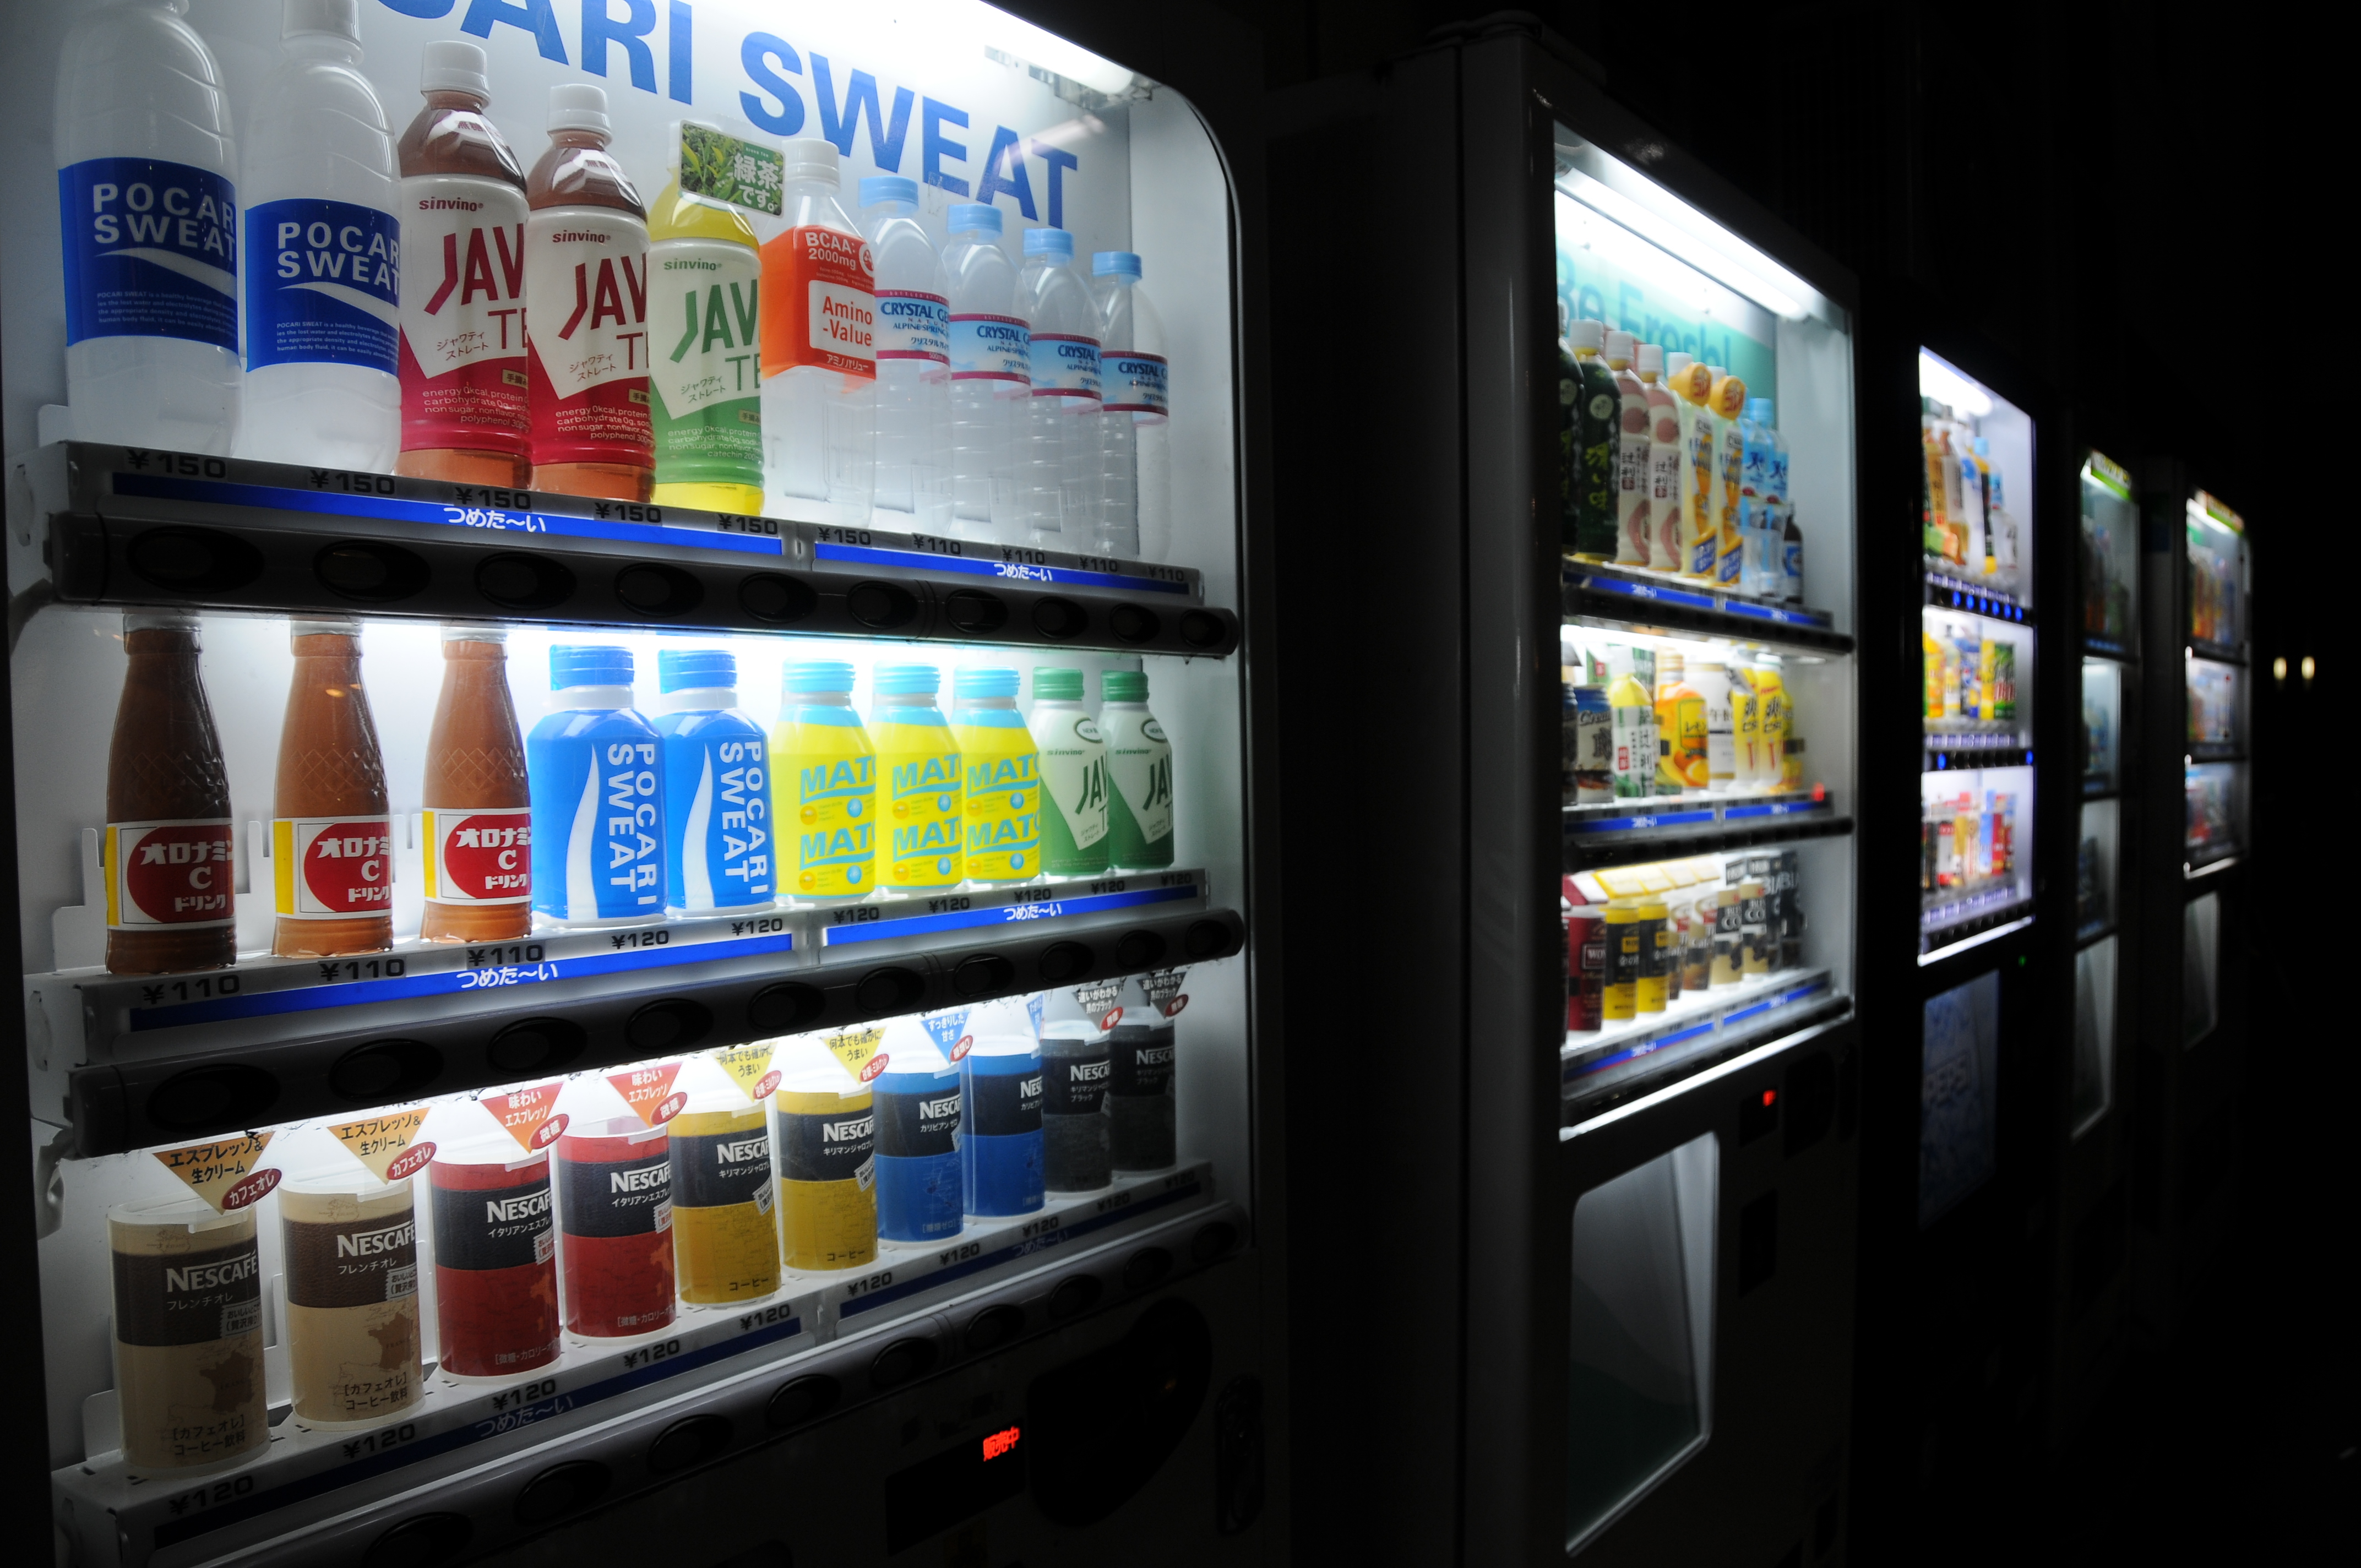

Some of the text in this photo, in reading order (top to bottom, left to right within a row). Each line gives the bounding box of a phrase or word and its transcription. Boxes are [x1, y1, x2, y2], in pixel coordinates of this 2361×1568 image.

[379, 0, 1078, 230] ARI SWEAT
[733, 152, 780, 192] 緑茶
[739, 184, 776, 212] です。
[94, 214, 236, 262] SWEAT
[805, 232, 855, 254] BCAA:
[808, 248, 856, 270] 2000mg
[277, 250, 400, 296] SWEAT
[822, 296, 873, 325] Amino
[880, 302, 934, 319] CRYSTAL
[823, 319, 873, 346] -Value
[893, 323, 921, 331] ALPINE
[976, 325, 1021, 342] CRYSTAL
[437, 331, 485, 351] ジャワティ
[445, 344, 488, 361] ストレート
[1058, 345, 1096, 361] CRYSTAL
[569, 353, 613, 373] ジャワティ
[577, 364, 617, 382] ストレート
[826, 354, 868, 372] アミノバリュー
[1118, 361, 1159, 377] CRYSTAL
[681, 375, 723, 395] ジャワティ
[688, 385, 726, 404] ストレート
[556, 407, 591, 417] energy
[618, 409, 647, 418] protein
[557, 414, 622, 425] carbohydrate
[590, 432, 635, 440] polyphenol
[127, 448, 227, 480] ¥150
[309, 469, 396, 495] ¥150
[455, 486, 532, 511] ¥150
[595, 502, 661, 524] ¥150
[719, 514, 778, 535] ¥150
[818, 526, 872, 546] ¥150
[913, 534, 961, 556] ¥110
[1003, 548, 1046, 564] ¥110
[1079, 556, 1118, 573] ¥110
[1148, 565, 1184, 582] ¥110
[607, 743, 637, 893] SWEAT
[719, 741, 749, 884] SWEAT
[745, 741, 769, 895] POCARI
[635, 743, 658, 906] POCARI
[498, 850, 518, 870] C
[189, 867, 212, 890] C
[361, 860, 380, 882] C
[1161, 873, 1192, 886] ¥120
[485, 874, 527, 890] ドリンク
[1091, 881, 1125, 895] ¥120
[174, 893, 227, 913] ドリンク
[348, 887, 391, 903] ドリンク
[929, 897, 970, 913] ¥120
[1014, 889, 1052, 903] ¥120
[834, 907, 879, 923] ¥120
[732, 918, 783, 936] ¥120
[612, 930, 670, 950] ¥120
[469, 945, 543, 967] ¥110
[320, 959, 406, 983] ¥110
[143, 975, 240, 1005] ¥110
[1078, 986, 1118, 1003] 違いがわかる
[928, 1014, 965, 1032] すっきりした
[942, 1029, 955, 1042] 甘さ
[846, 1049, 868, 1062] うまい
[632, 1069, 662, 1087] 味わい
[738, 1064, 760, 1078] うまい
[509, 1089, 542, 1110] 味わい
[629, 1084, 668, 1103] エスプレッソ
[505, 1105, 547, 1128] エスプレッソ
[660, 1096, 679, 1119] 微糖
[539, 1118, 561, 1144] 微糖
[920, 1121, 949, 1133] カリビアン
[360, 1134, 406, 1156] 生クリーム
[391, 1145, 432, 1178] カフェオレ
[191, 1159, 246, 1185] 生クリーム
[1165, 1172, 1195, 1190] ¥120
[229, 1173, 275, 1207] カフェオレ
[1097, 1193, 1130, 1211] ¥120
[1022, 1217, 1059, 1238] ¥120
[827, 1250, 865, 1261] コーヒー
[940, 1243, 980, 1266] ¥120
[338, 1257, 397, 1275] フレンチオレ
[729, 1277, 769, 1292] コーヒー
[848, 1272, 892, 1297] ¥120
[166, 1291, 233, 1311] フレンチオレ
[741, 1304, 790, 1331] ¥120
[624, 1340, 680, 1369] ¥120
[346, 1386, 408, 1412] コーヒー飲料
[493, 1379, 557, 1411] ¥120
[175, 1429, 246, 1456] コーヒー飲料
[344, 1424, 416, 1458] ¥120
[983, 1425, 1020, 1462] 販売中
[169, 1476, 253, 1515] ¥120
